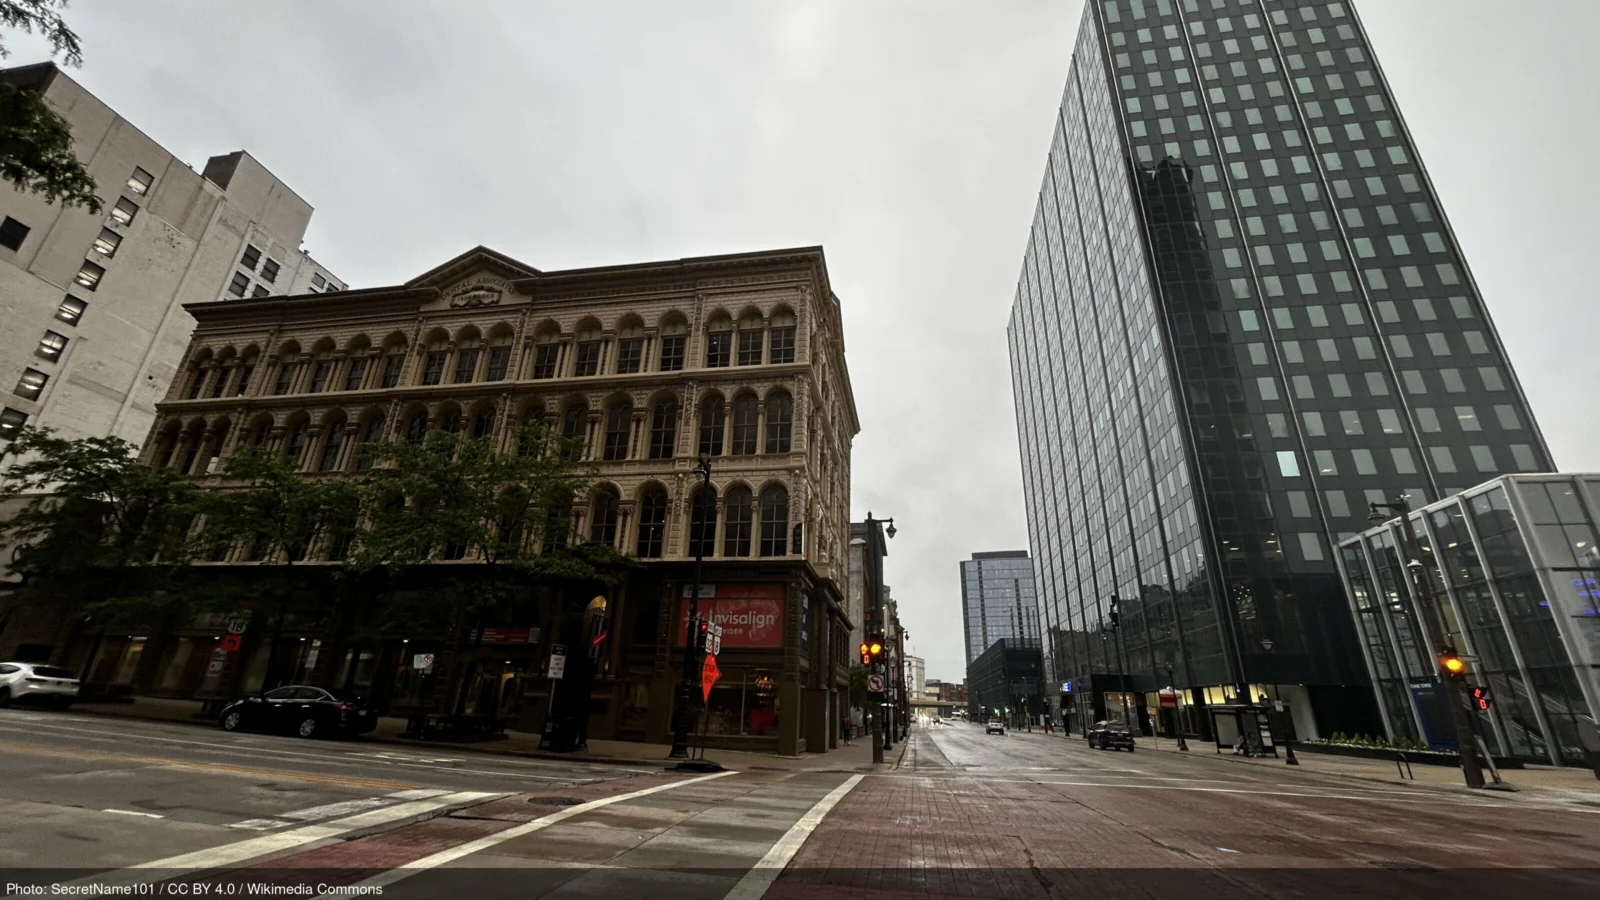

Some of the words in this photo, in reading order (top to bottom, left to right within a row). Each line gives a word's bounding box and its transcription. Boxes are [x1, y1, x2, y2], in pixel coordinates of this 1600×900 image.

[441, 280, 472, 301] DENTAL
[476, 277, 516, 296] ASSOCIATES
[232, 622, 243, 632] 18
[710, 609, 774, 628] invisalign
